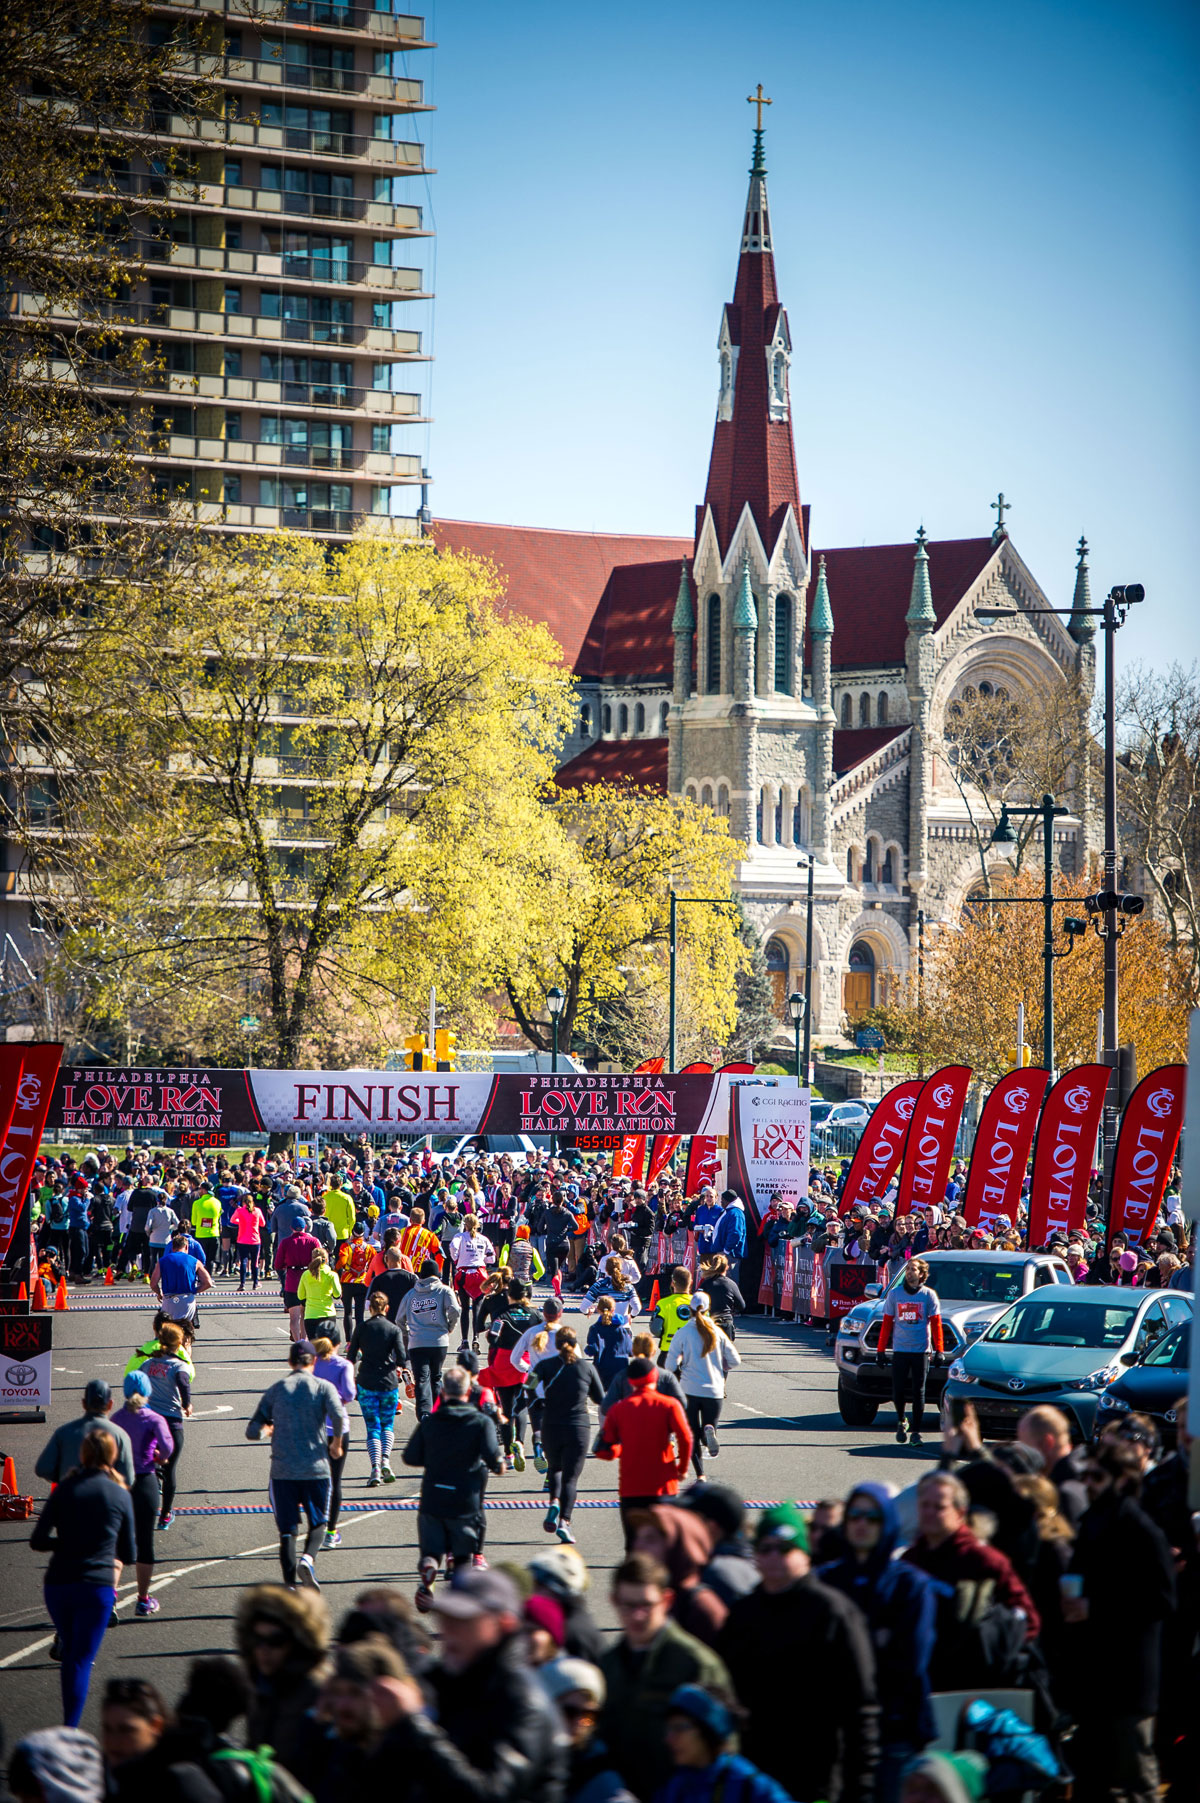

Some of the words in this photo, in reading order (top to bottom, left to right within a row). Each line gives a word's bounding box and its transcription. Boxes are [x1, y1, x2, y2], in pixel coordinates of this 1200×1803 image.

[73, 1071, 211, 1084] PHILADELPHIA
[529, 1077, 665, 1088] PHILADELPHIA
[62, 1085, 153, 1111] LOVE
[159, 1082, 222, 1112] RUN
[293, 1084, 460, 1121] FINISH
[519, 1090, 609, 1116] LOVE
[613, 1086, 678, 1116] RUN
[762, 1098, 776, 1106] CGI
[63, 1111, 112, 1126] HALF
[117, 1113, 222, 1128] MARATHON
[520, 1117, 570, 1131] HALF
[574, 1117, 677, 1131] MARATHON
[753, 1124, 806, 1139] LOVE
[752, 1137, 804, 1160] RUN
[859, 1121, 905, 1196] LOVE
[912, 1114, 945, 1195] LOVE
[981, 1119, 1020, 1205] LOVE
[1048, 1120, 1083, 1211] LOVE
[1123, 1124, 1165, 1220] LOVE
[0, 1123, 34, 1239] LOVE
[4, 1322, 40, 1333] LOVE
[4, 1331, 40, 1347] RUN
[2, 1388, 41, 1396] TOYOTA
